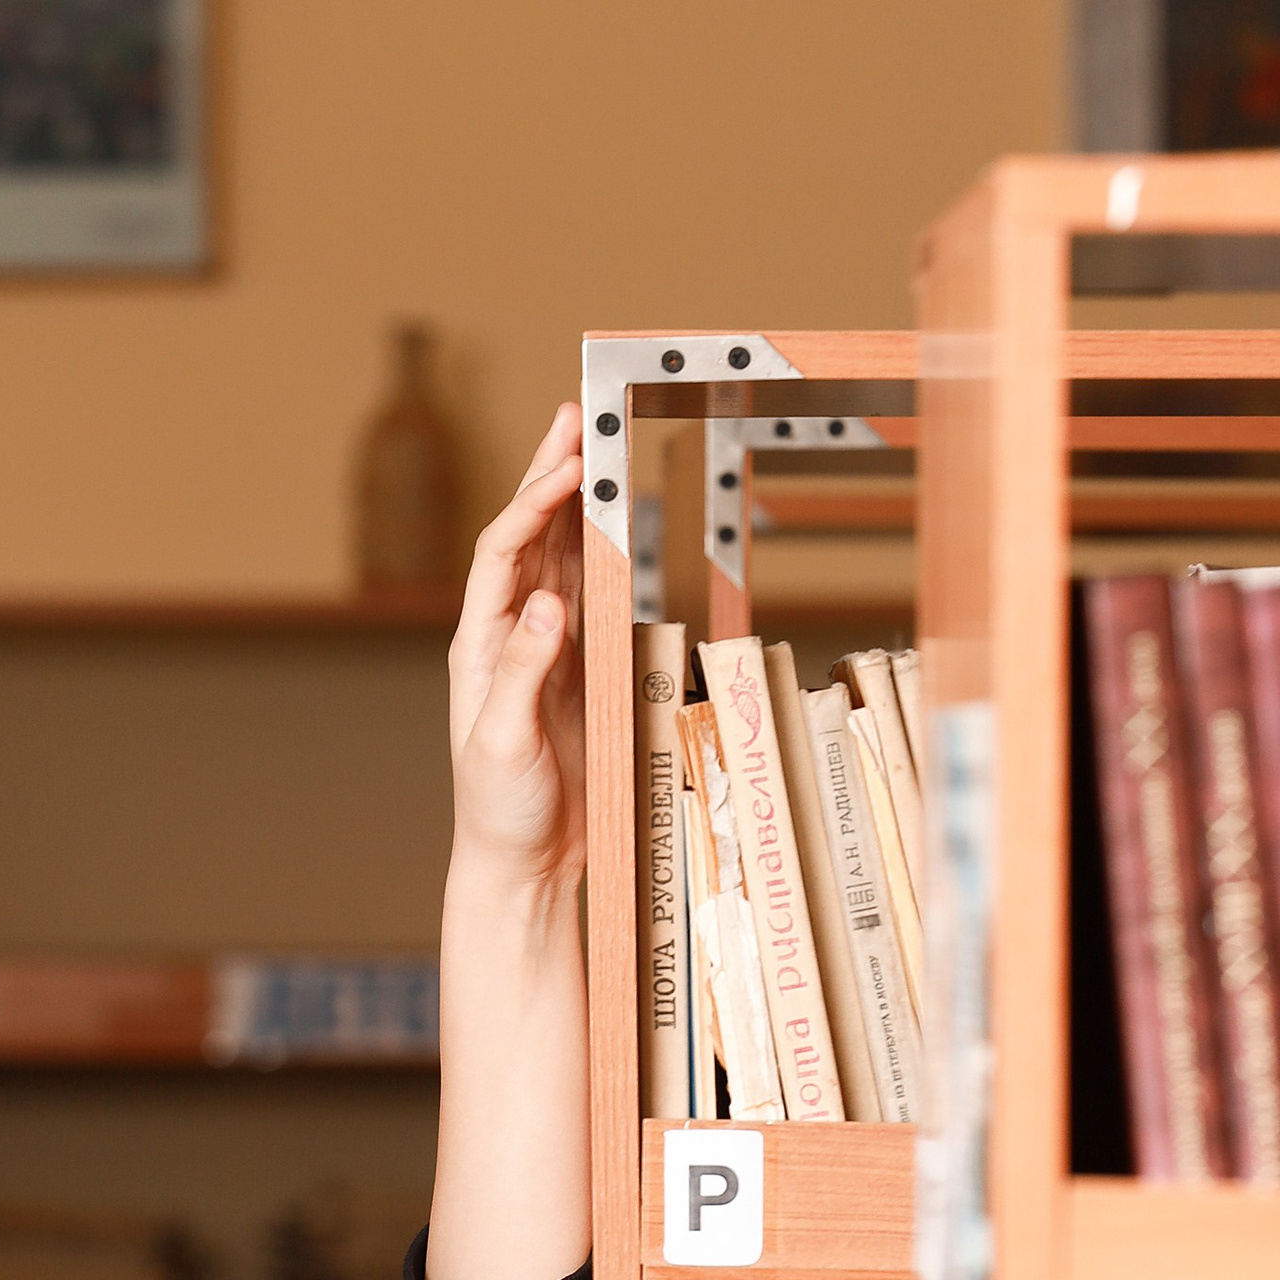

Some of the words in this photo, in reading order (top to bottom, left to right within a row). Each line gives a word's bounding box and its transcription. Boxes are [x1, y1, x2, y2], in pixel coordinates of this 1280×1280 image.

[826, 741, 856, 836] РАДИЩЕВ
[650, 750, 675, 924] РУСТАВЕЛИ
[653, 938, 677, 1030] ШОТА
[869, 955, 888, 1000] МОСКВУ
[881, 1012, 903, 1082] ПЕТЕРБУРГА
[688, 1164, 739, 1231] Р
